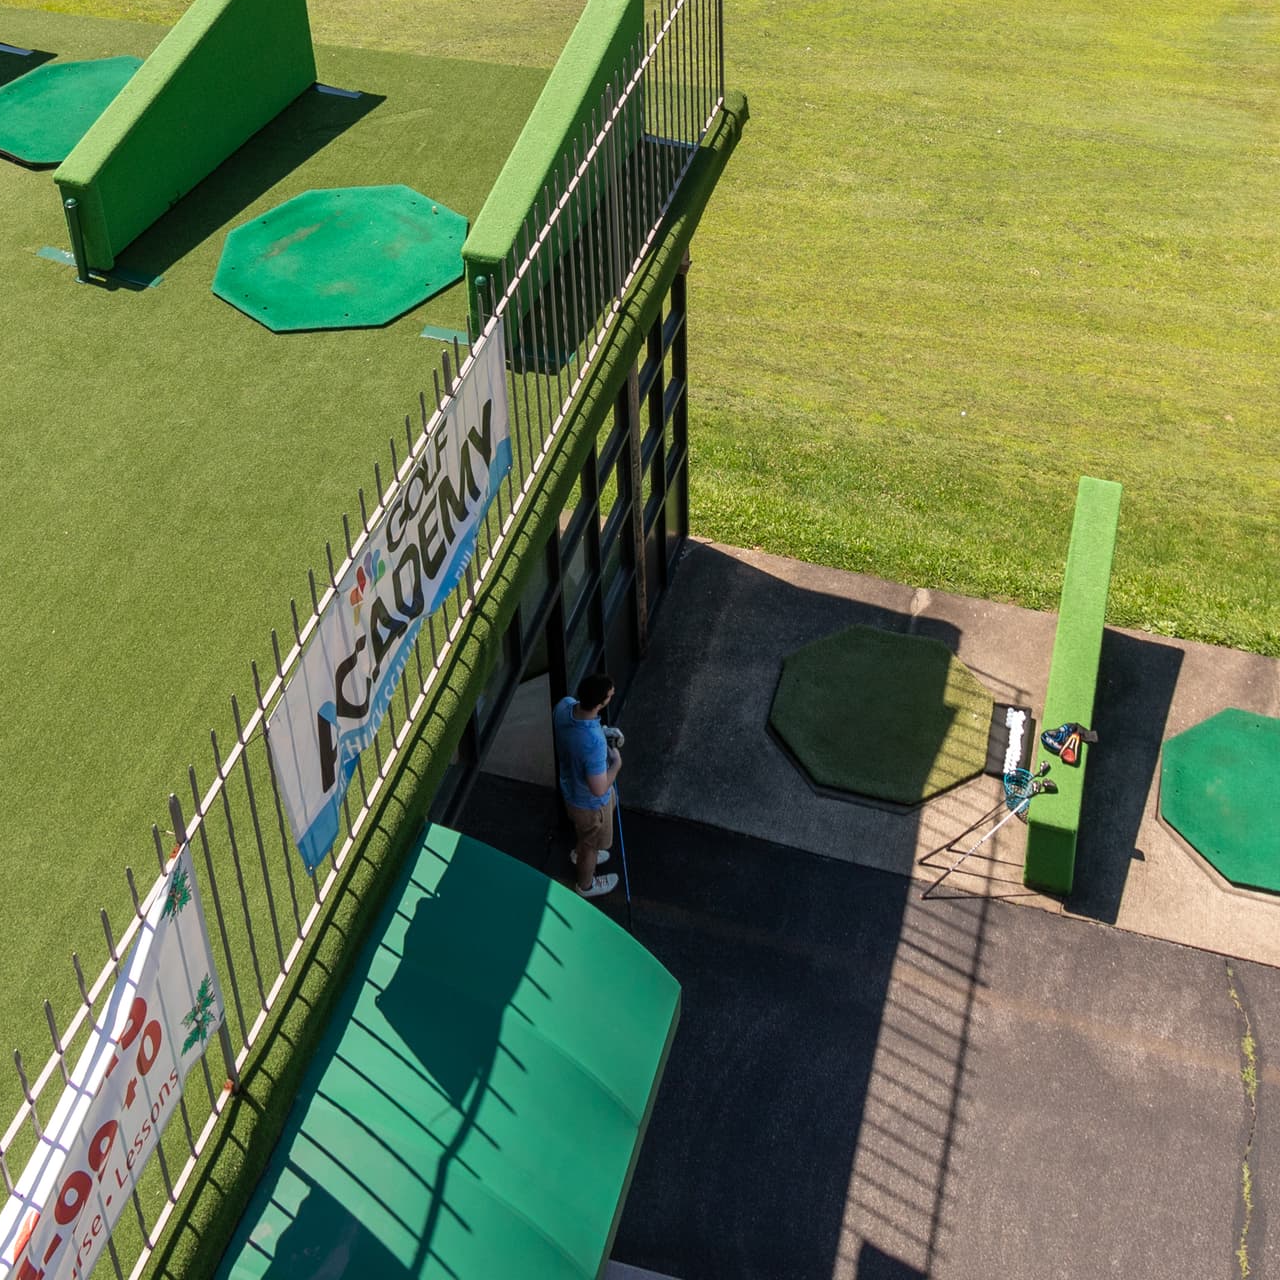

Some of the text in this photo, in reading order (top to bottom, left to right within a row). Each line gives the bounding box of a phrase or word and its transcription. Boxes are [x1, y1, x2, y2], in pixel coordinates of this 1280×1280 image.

[386, 416, 448, 553] GOLF
[318, 398, 492, 794] ACADEMY
[116, 1066, 180, 1189] Lessons
